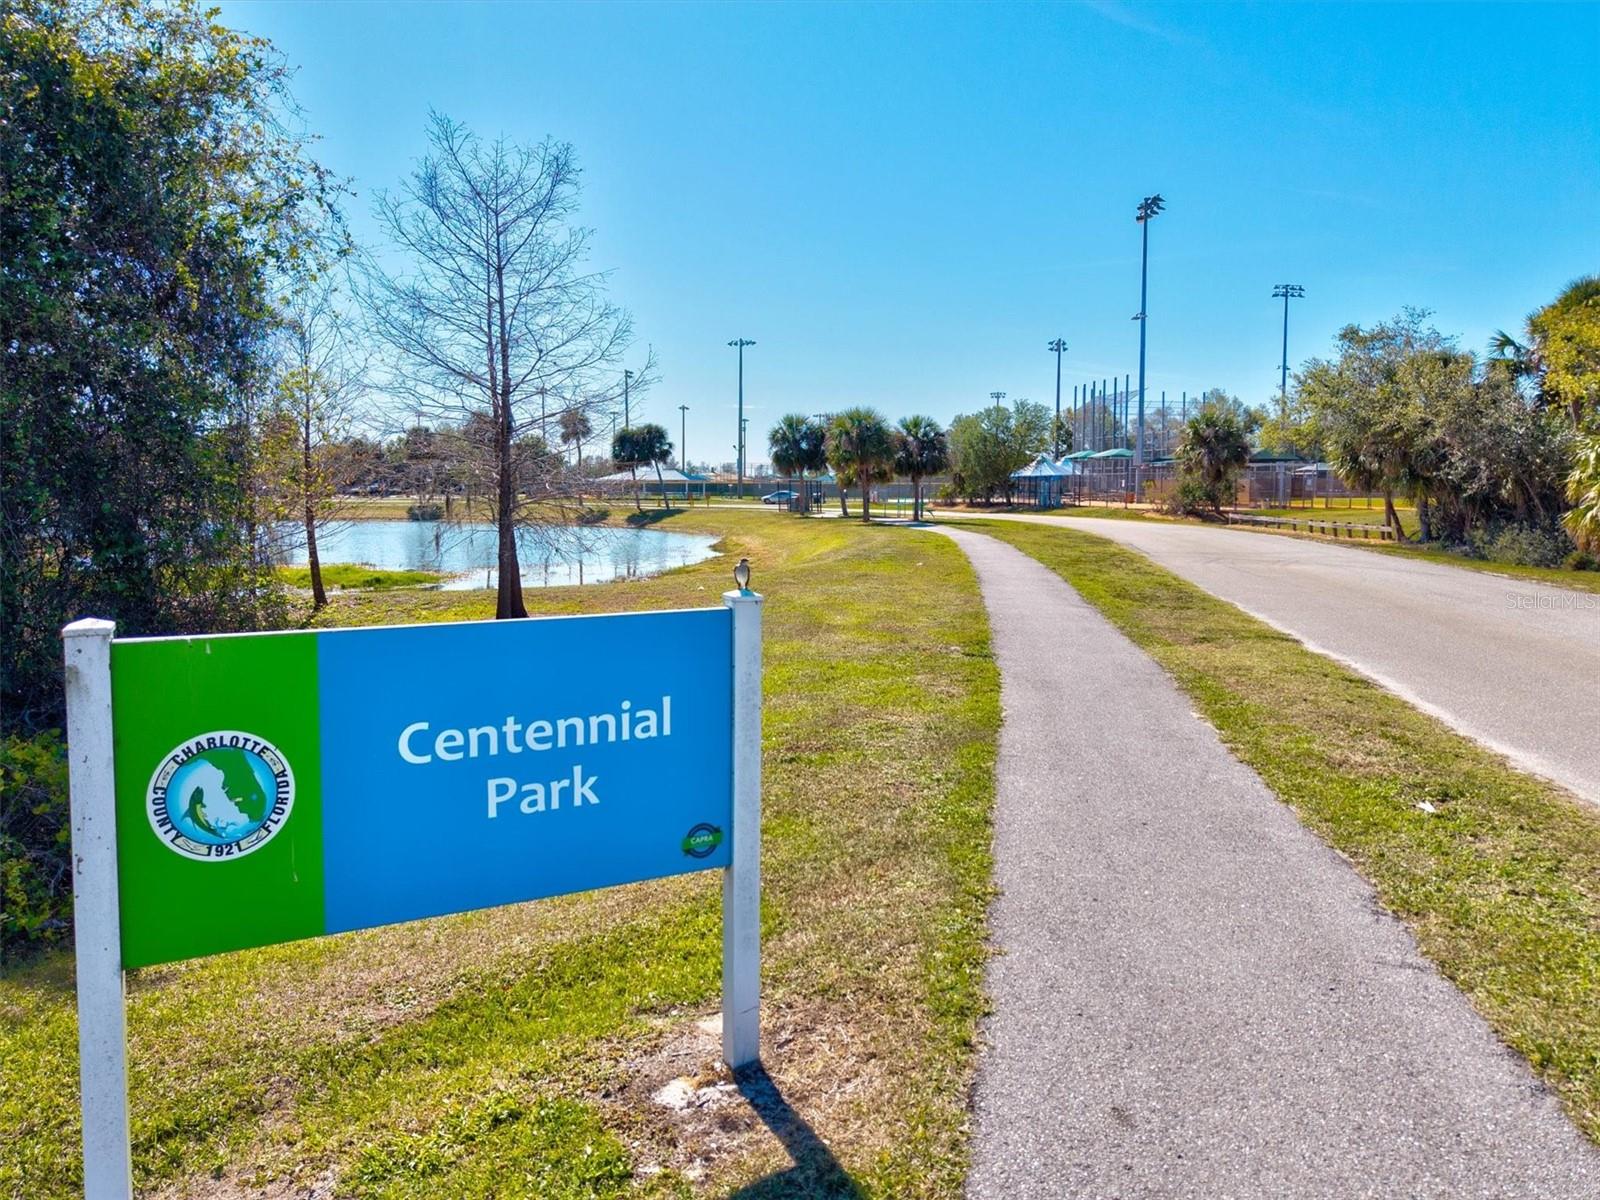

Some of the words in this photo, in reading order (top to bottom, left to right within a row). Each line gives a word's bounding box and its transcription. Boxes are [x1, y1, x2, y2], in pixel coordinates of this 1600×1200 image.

[172, 735, 269, 767] CHARLOTTE
[398, 695, 671, 764] Centennial
[152, 786, 182, 843] COUNTY
[262, 769, 290, 833] FLORIDA
[487, 765, 600, 818] Park
[206, 840, 242, 857] 1921
